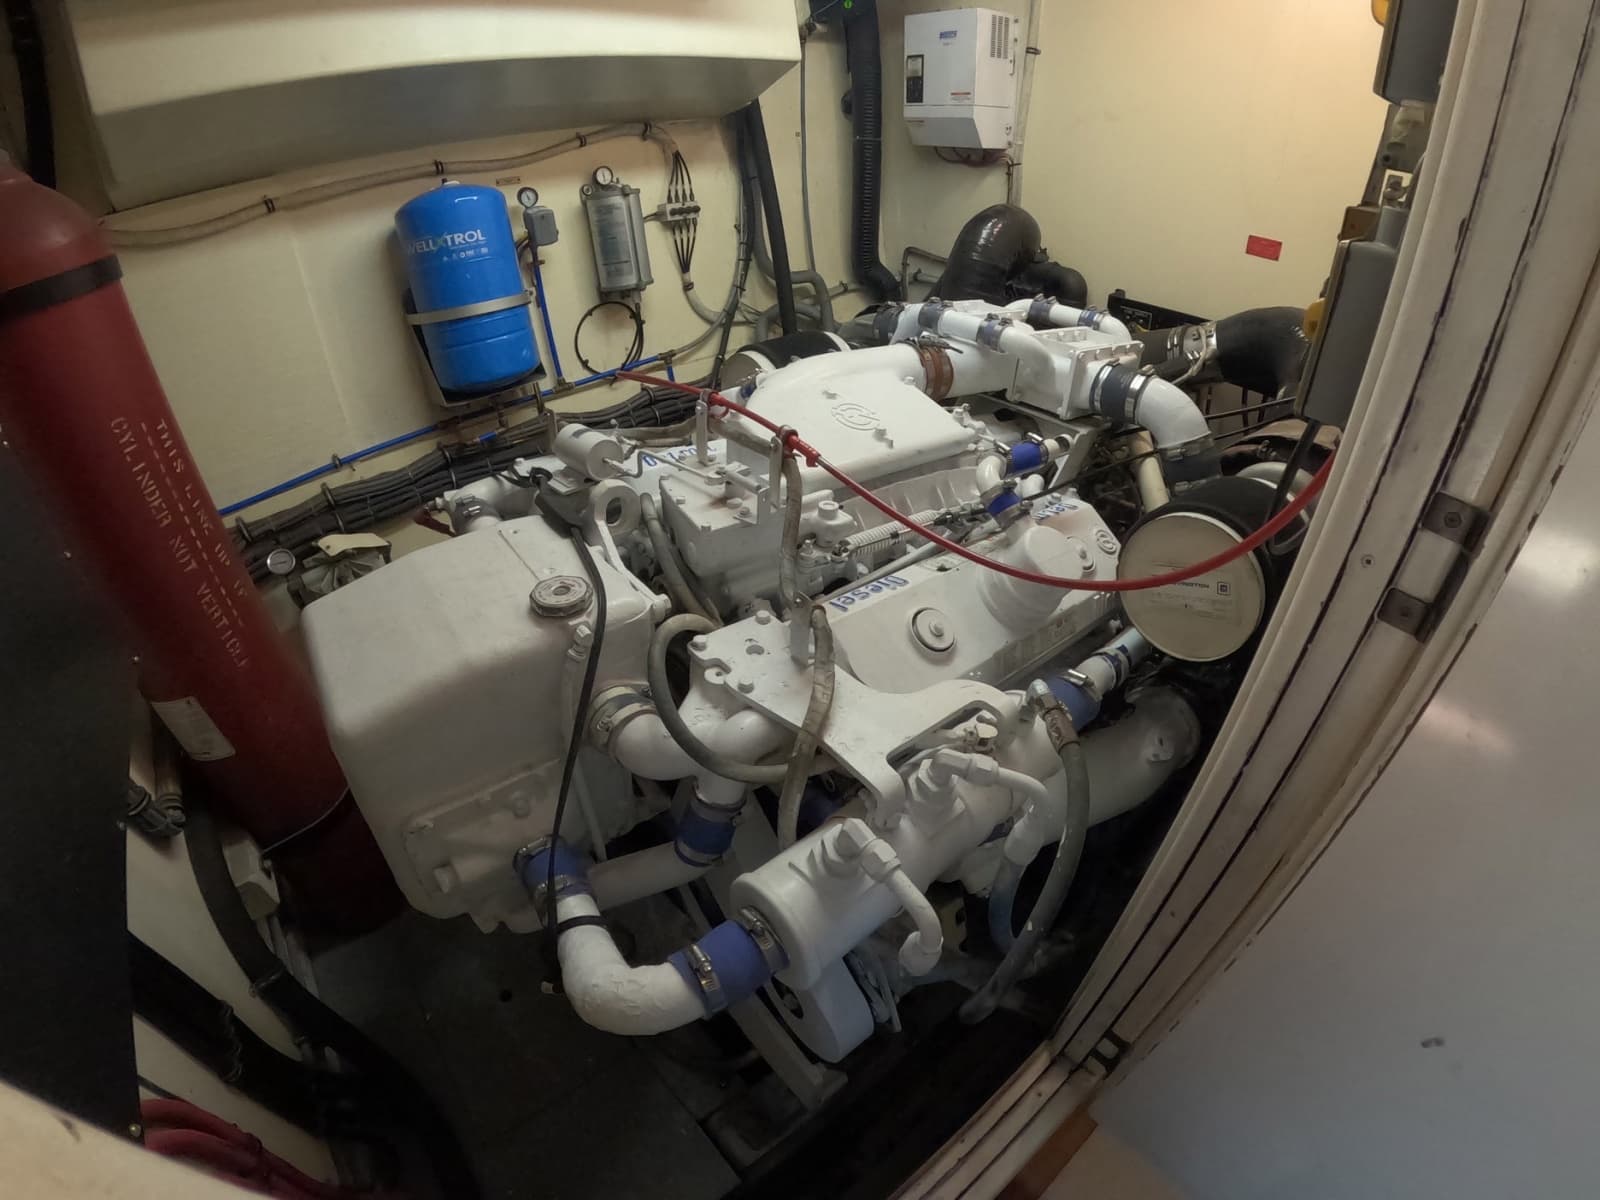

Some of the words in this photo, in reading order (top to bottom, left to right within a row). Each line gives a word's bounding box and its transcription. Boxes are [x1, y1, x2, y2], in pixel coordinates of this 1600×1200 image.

[156, 418, 185, 472] THIS
[111, 416, 173, 529] CYLINDER
[168, 535, 199, 573] NOT
[829, 574, 910, 612] Diesel
